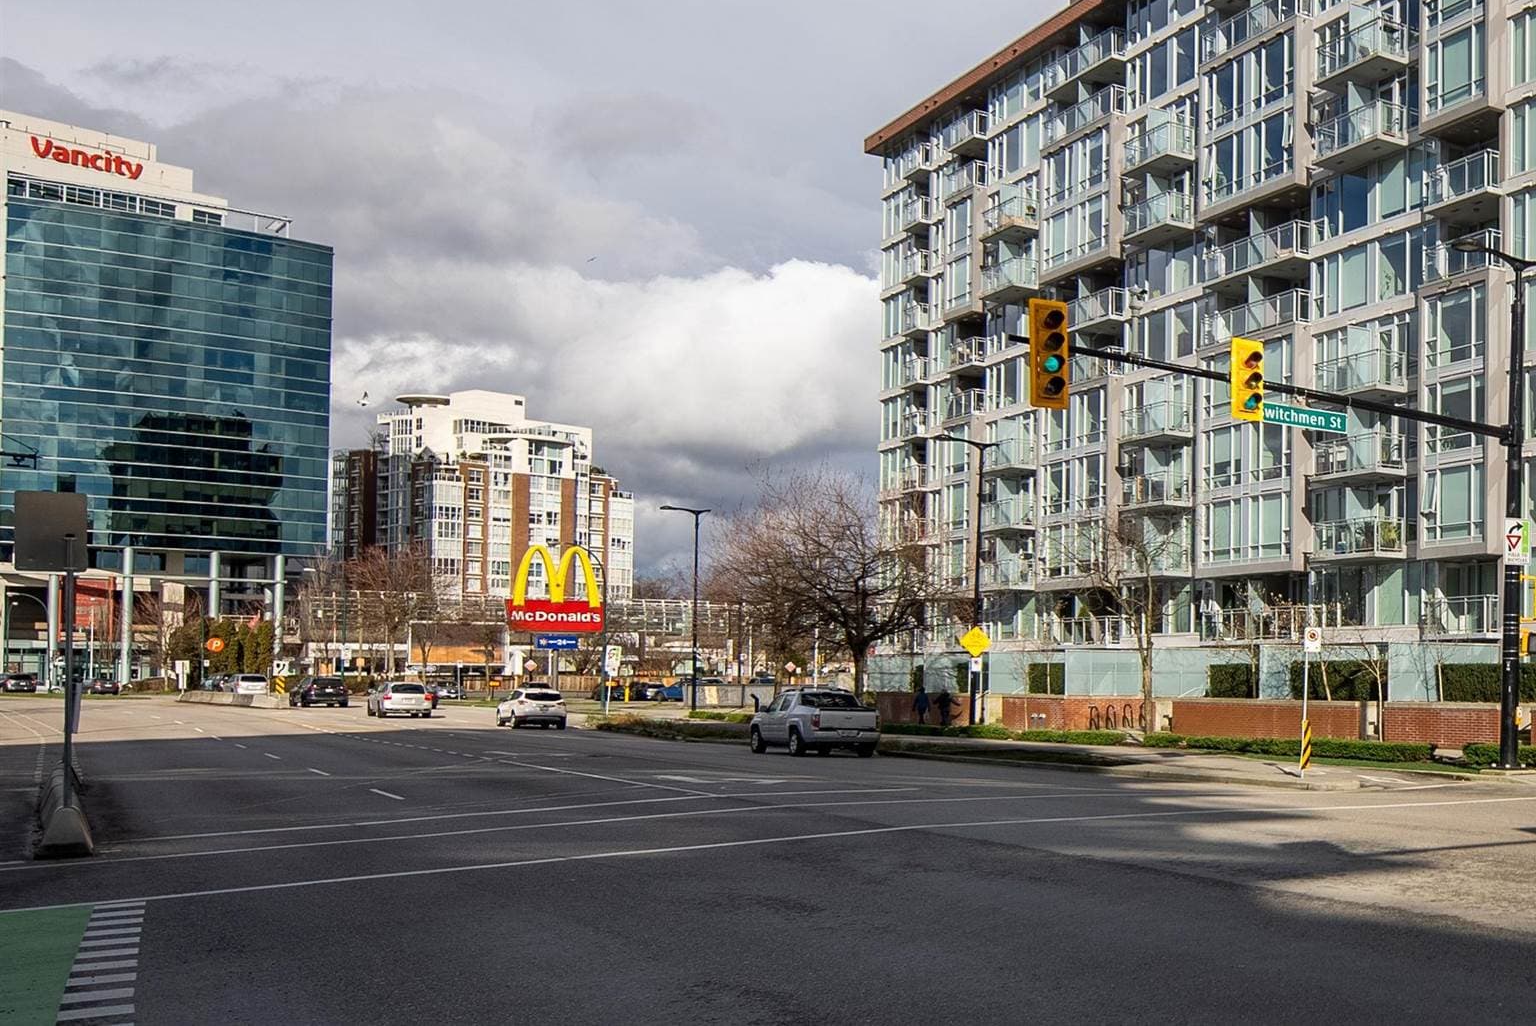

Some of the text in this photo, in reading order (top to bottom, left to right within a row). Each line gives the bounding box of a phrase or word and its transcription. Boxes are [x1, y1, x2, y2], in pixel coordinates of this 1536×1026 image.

[31, 136, 143, 180] Vancity
[1264, 407, 1342, 429] witchmen St
[511, 610, 601, 623] McDonald's
[212, 639, 222, 650] P
